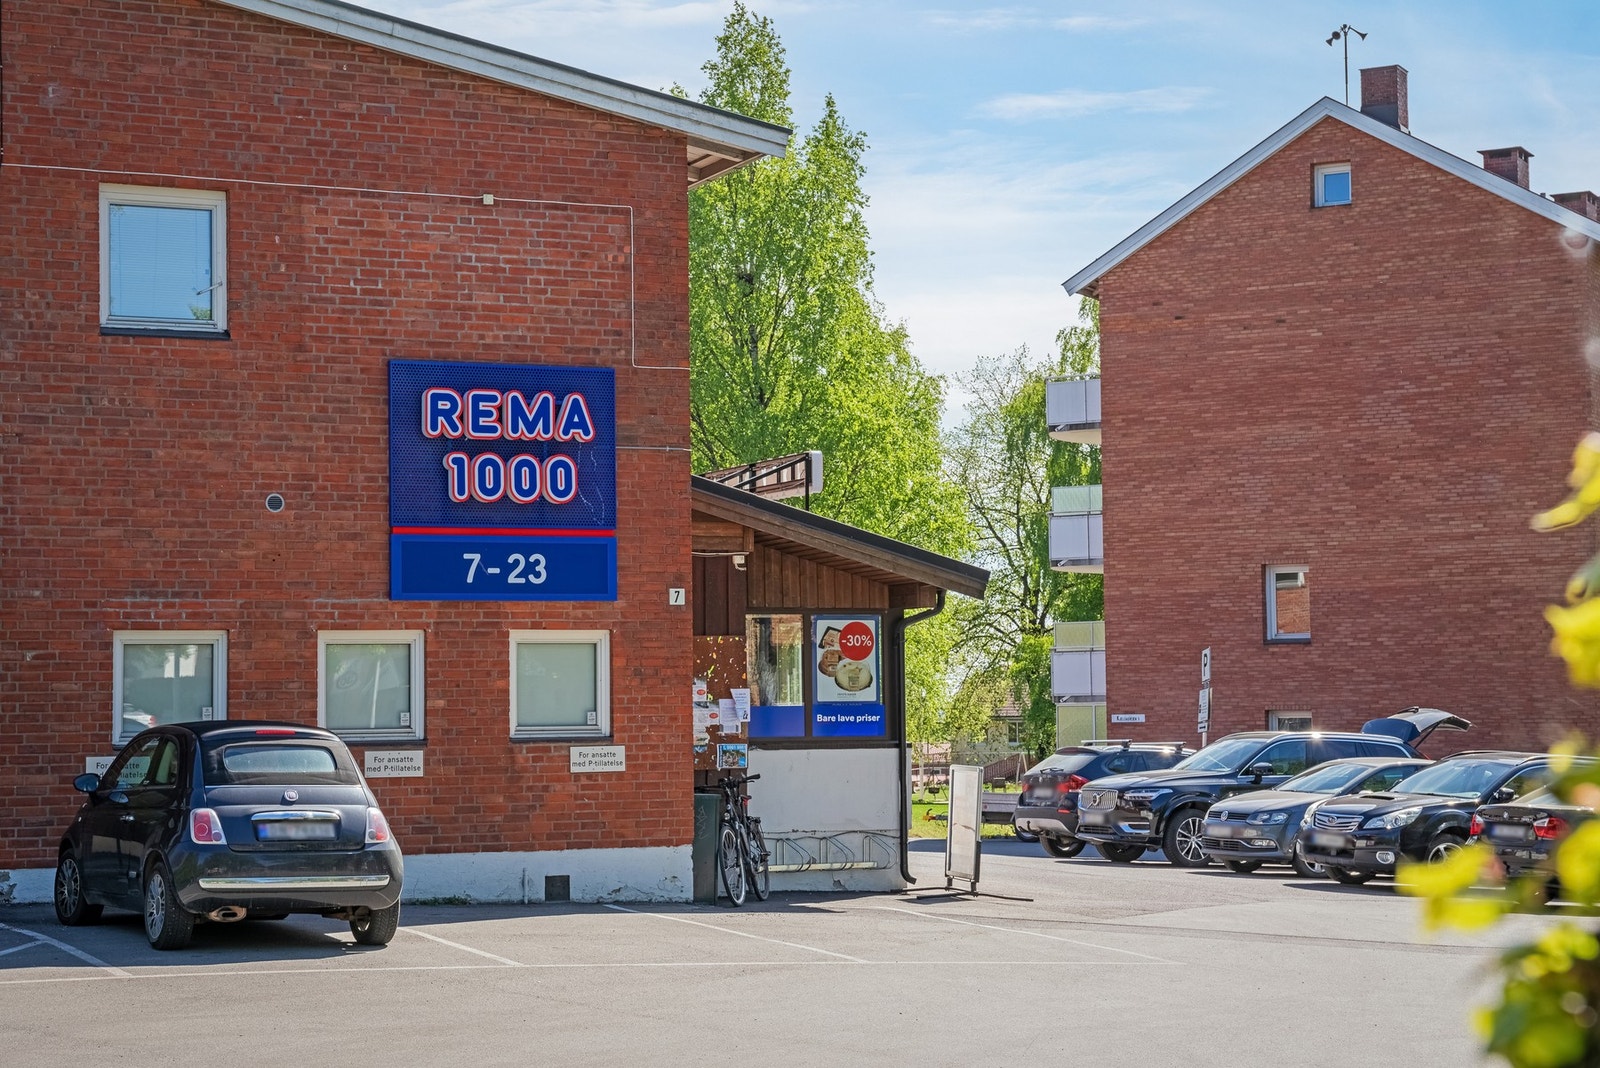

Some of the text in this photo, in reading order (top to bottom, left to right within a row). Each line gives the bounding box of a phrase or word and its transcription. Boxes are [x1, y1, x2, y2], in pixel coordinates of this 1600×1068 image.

[421, 387, 597, 443] REMA
[443, 451, 579, 505] 1000
[674, 590, 681, 603] 7
[841, 634, 872, 647] -30%
[816, 713, 881, 724] Bare lave priser
